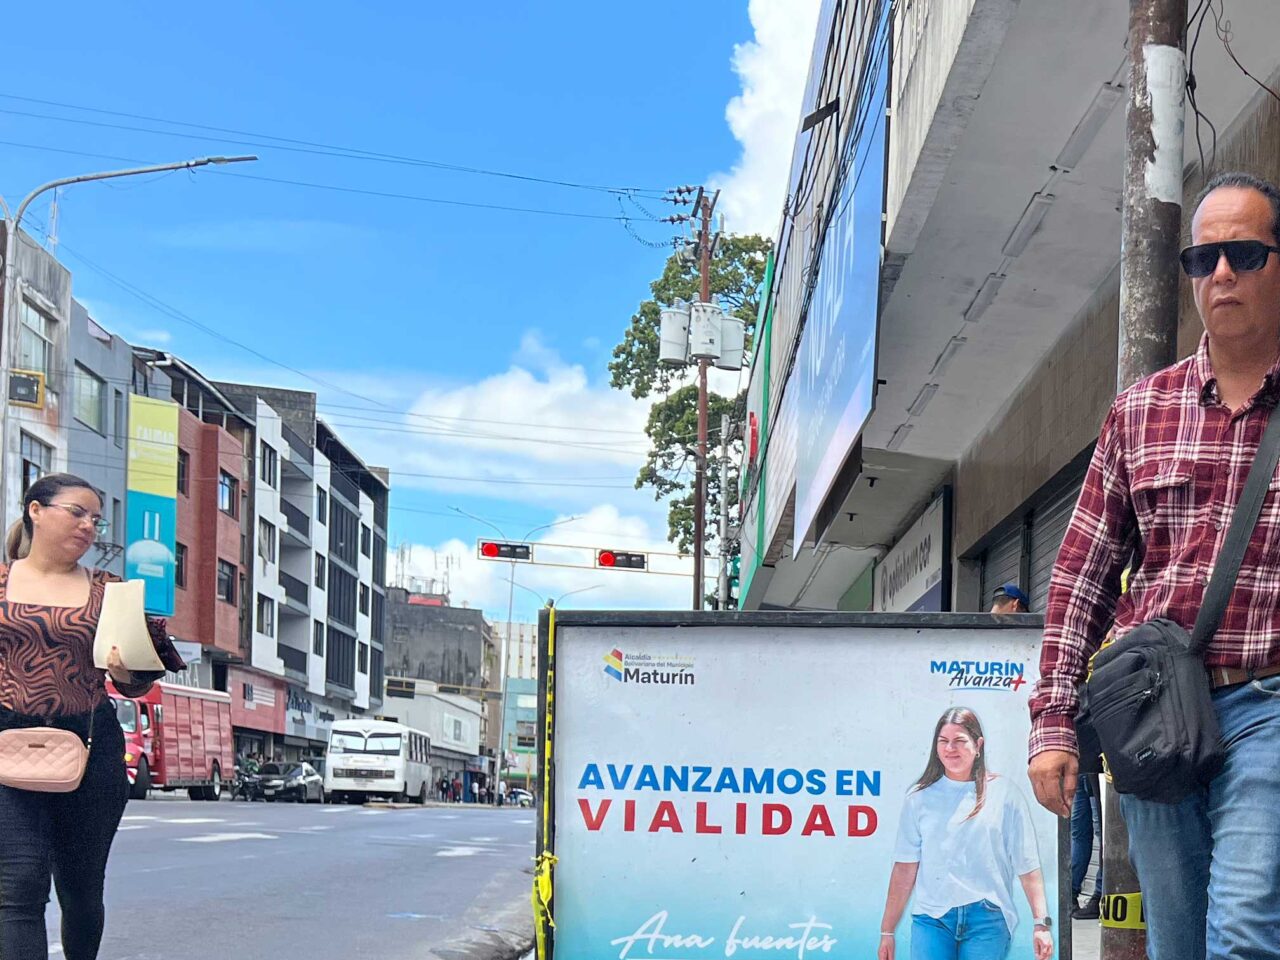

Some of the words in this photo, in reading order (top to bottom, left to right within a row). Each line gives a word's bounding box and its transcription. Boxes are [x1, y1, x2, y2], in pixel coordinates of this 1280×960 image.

[623, 667, 695, 685] Maturín
[578, 763, 827, 795] AVANZAMOS
[835, 769, 881, 796] EN
[577, 798, 878, 837] VIALIDAD
[610, 910, 715, 960] Ana
